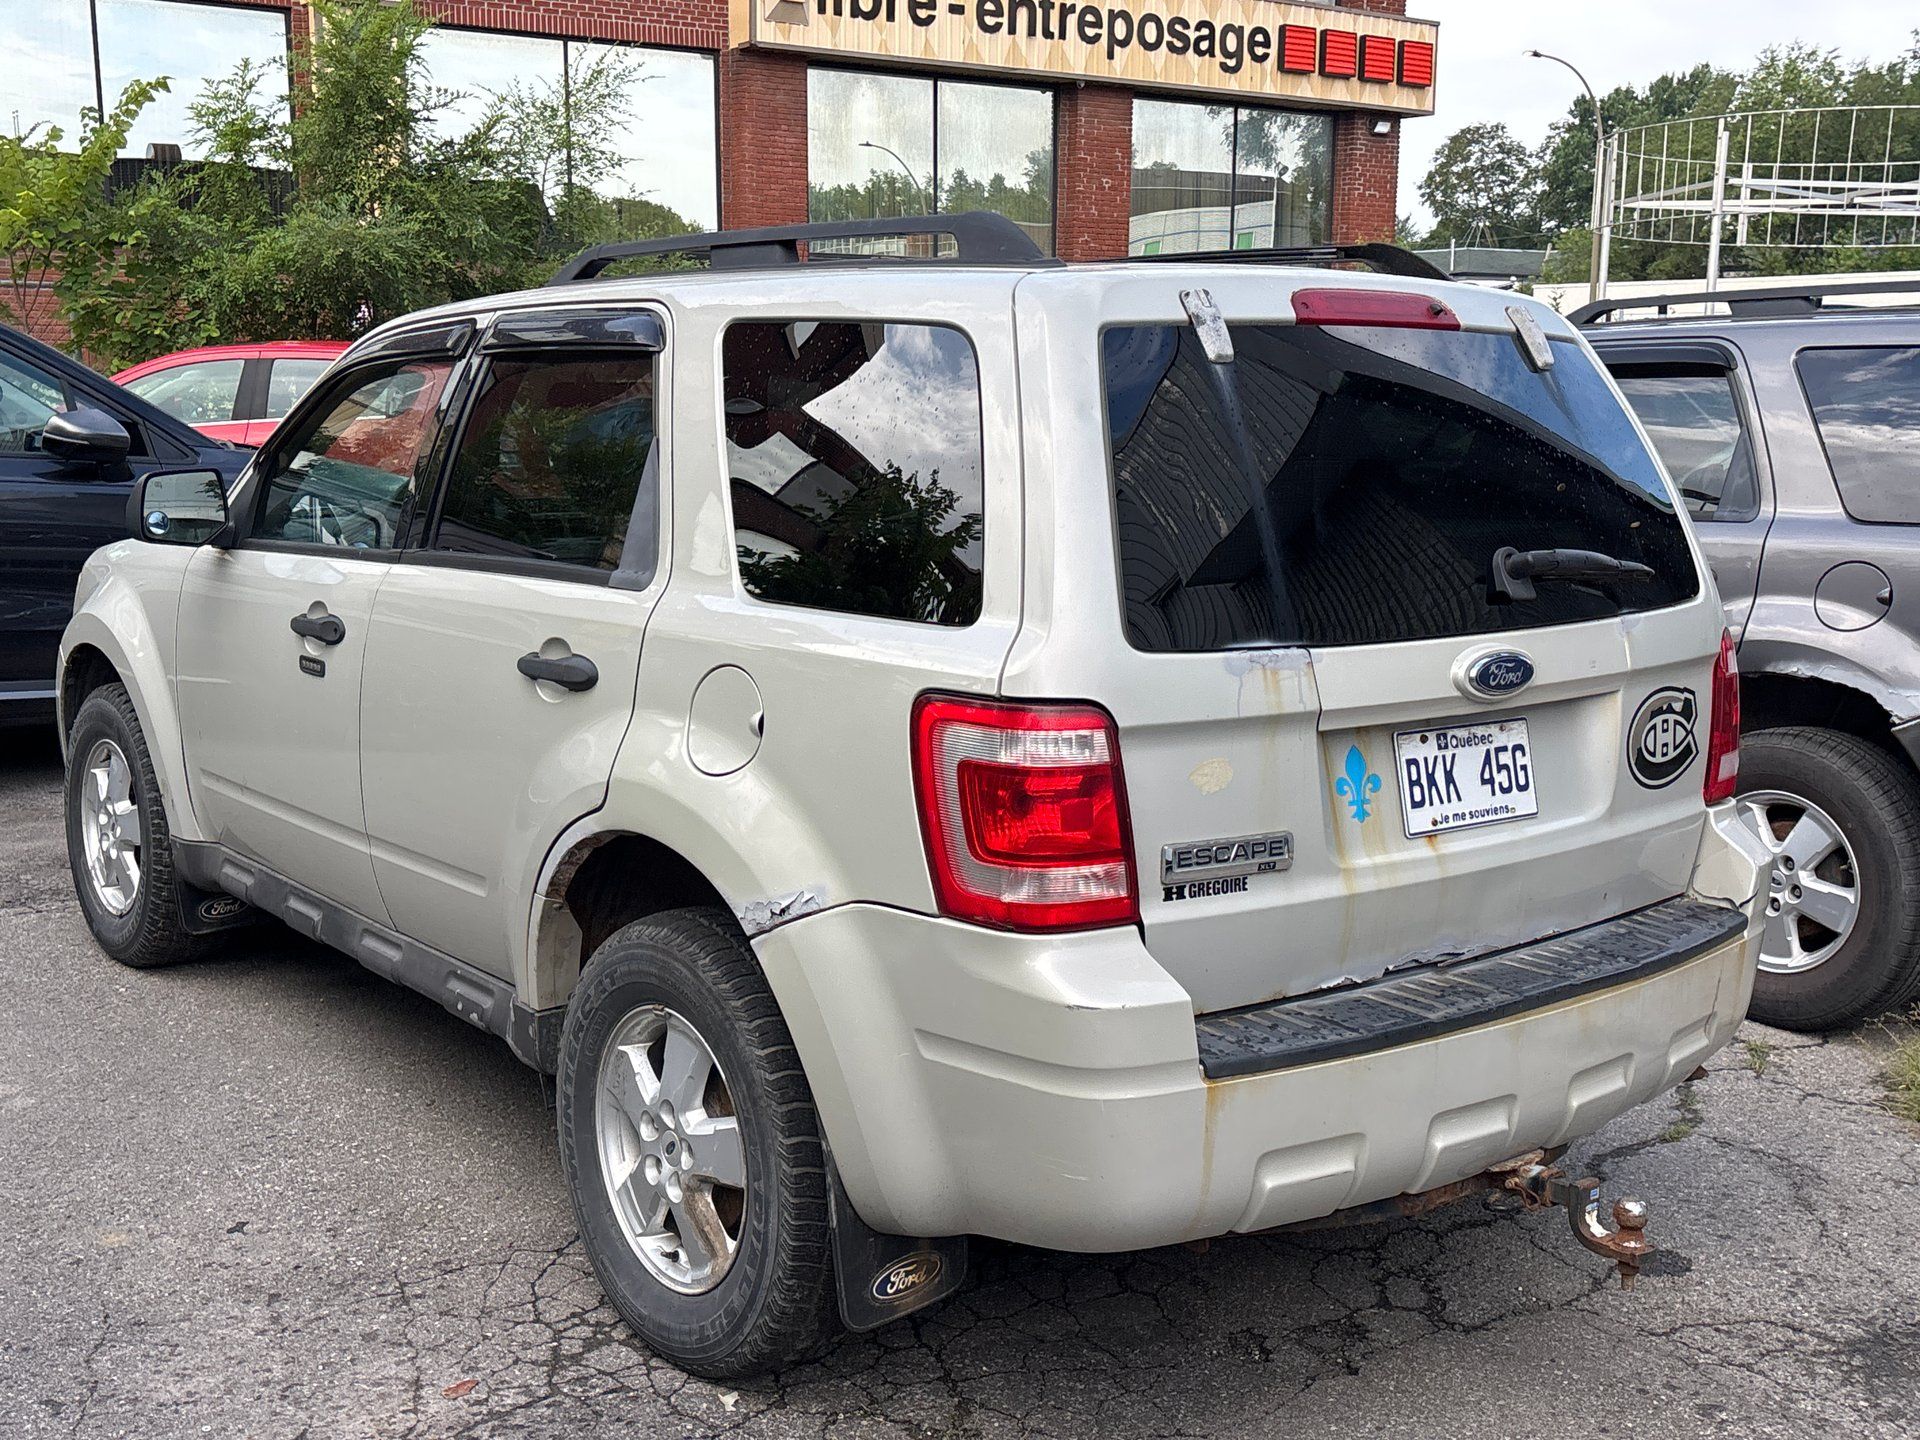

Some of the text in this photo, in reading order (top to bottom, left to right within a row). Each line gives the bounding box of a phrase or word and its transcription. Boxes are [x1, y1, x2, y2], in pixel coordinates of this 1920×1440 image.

[975, 0, 1272, 74] entreposage
[1488, 661, 1524, 687] Ford
[1405, 743, 1530, 809] BKK 45G
[1438, 803, 1510, 825] Je me souviens
[1176, 839, 1284, 869] ESCAPE
[1259, 862, 1276, 871] XLT
[211, 899, 240, 915] Ford
[886, 1263, 927, 1294] Ford
